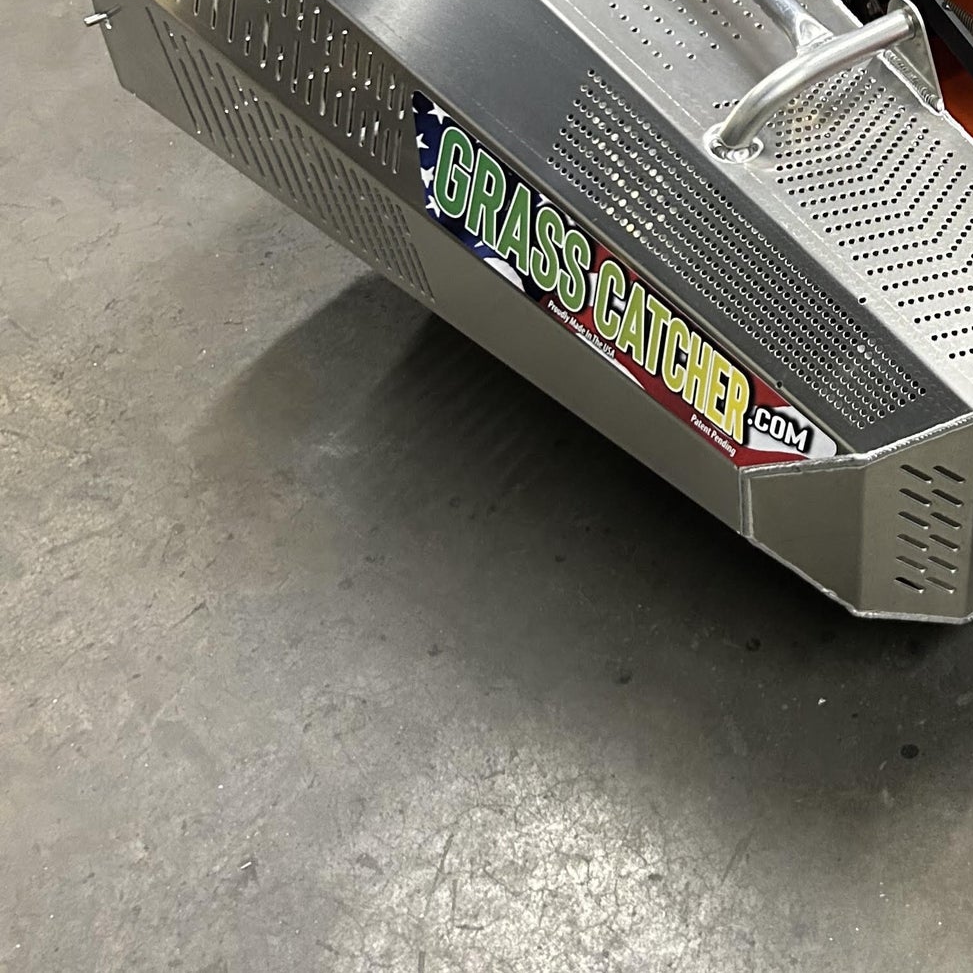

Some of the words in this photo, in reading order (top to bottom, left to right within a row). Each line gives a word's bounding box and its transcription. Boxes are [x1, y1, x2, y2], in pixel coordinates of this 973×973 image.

[433, 126, 592, 313] GRASS
[593, 259, 750, 445] CATCHER
[547, 300, 571, 325] Proudly
[569, 318, 586, 335] Made
[585, 328, 592, 340] In
[591, 334, 604, 348] The
[603, 342, 616, 359] USA
[690, 413, 712, 437] Patent
[711, 429, 737, 457] Pending
